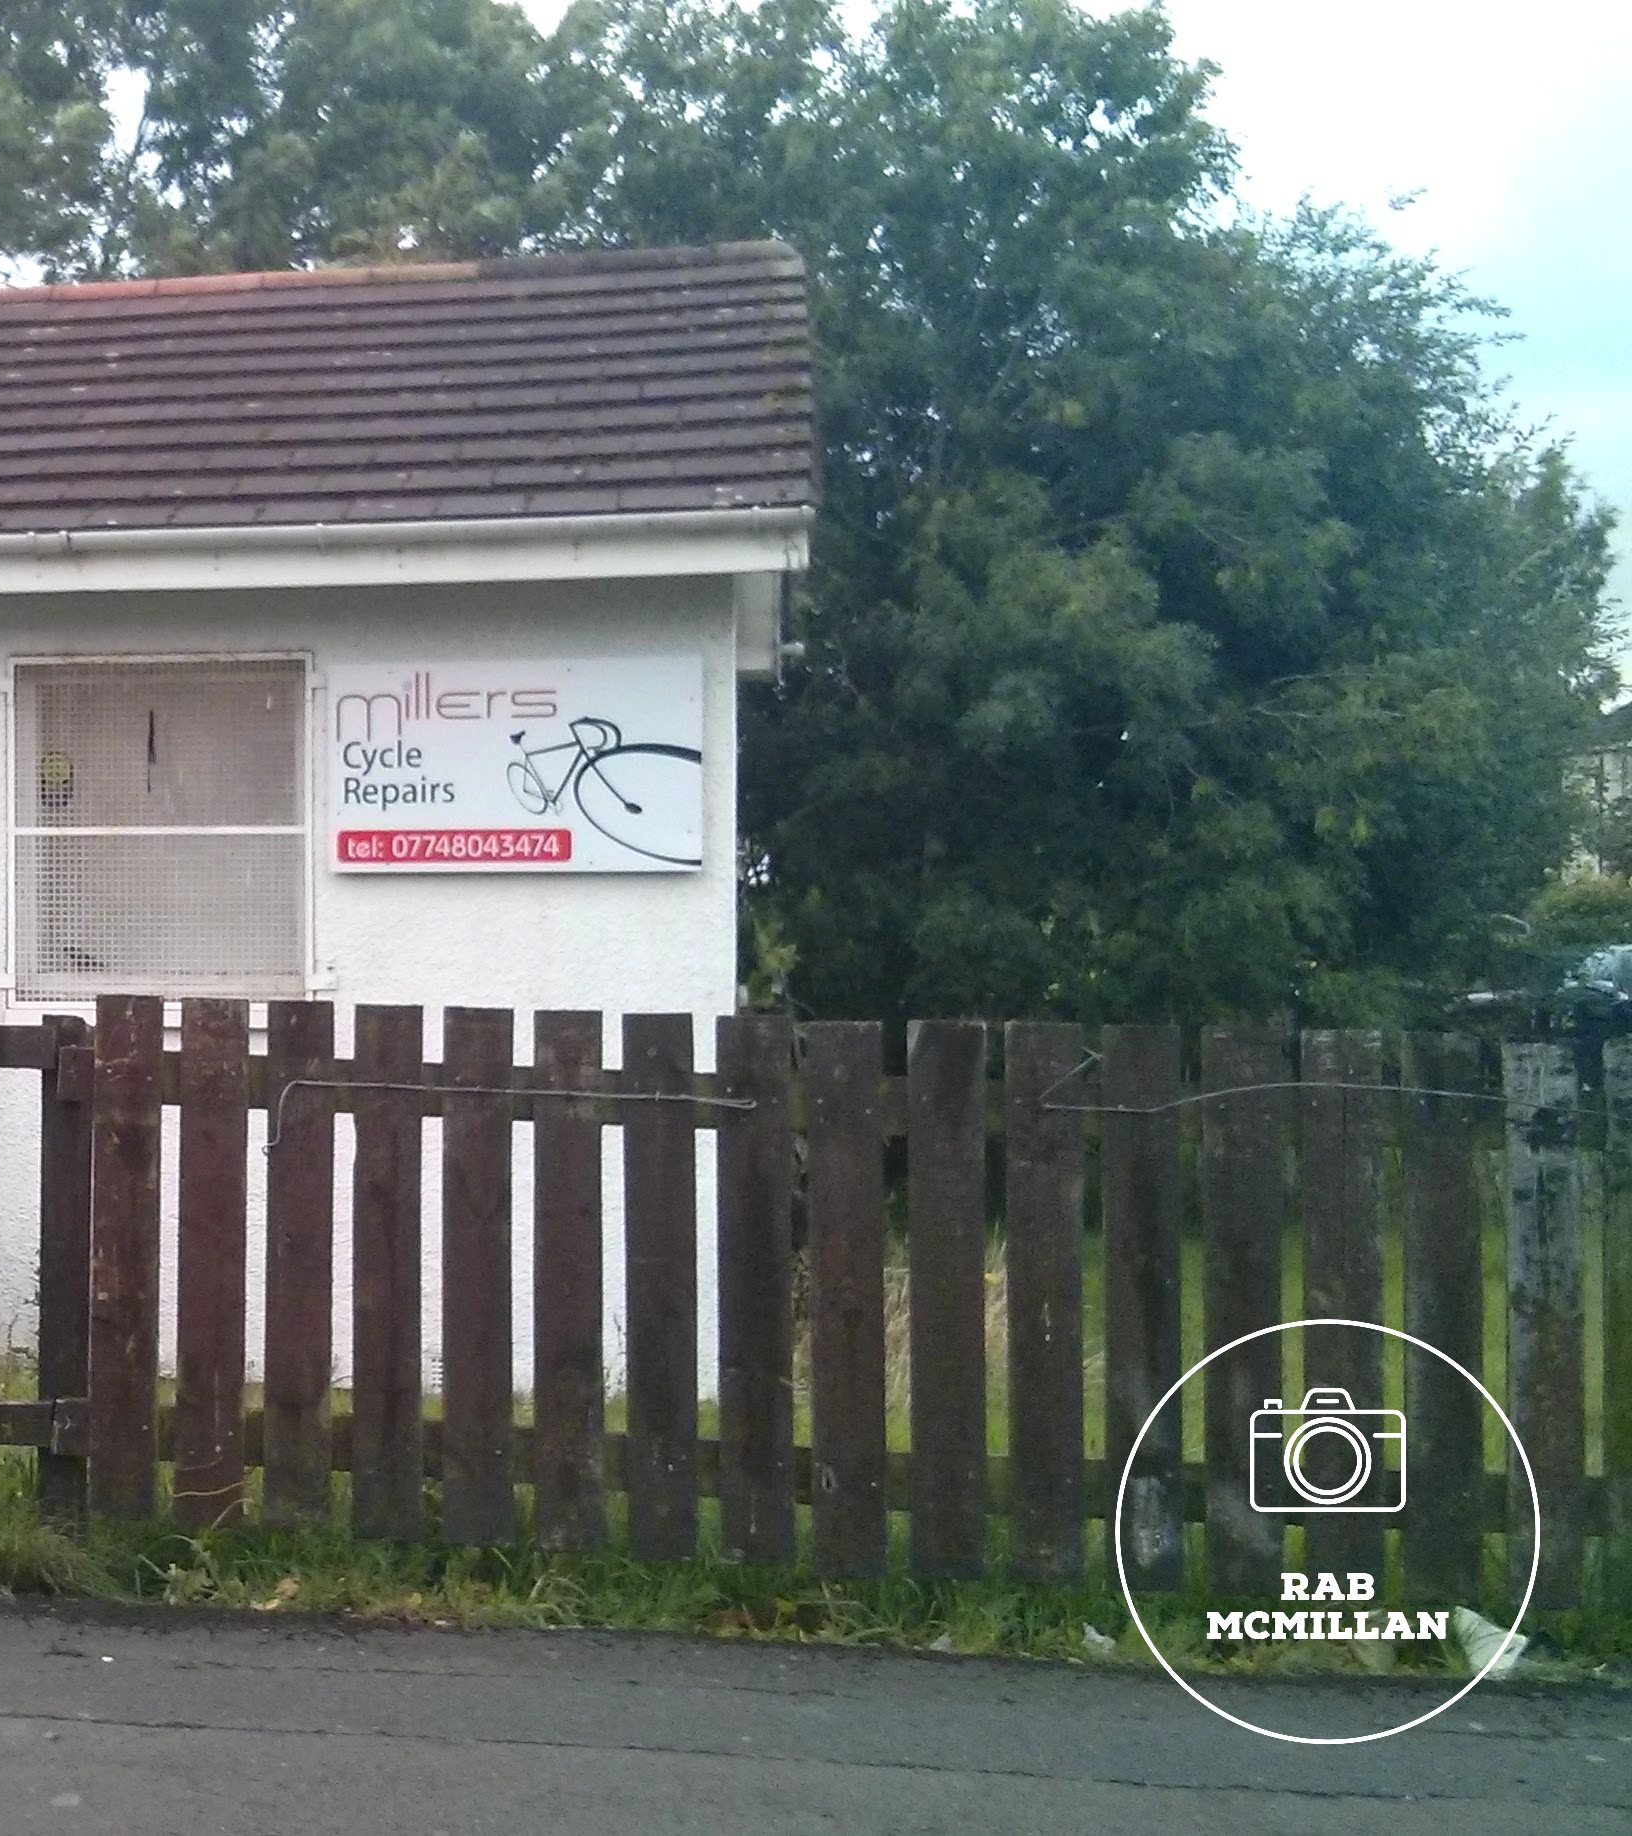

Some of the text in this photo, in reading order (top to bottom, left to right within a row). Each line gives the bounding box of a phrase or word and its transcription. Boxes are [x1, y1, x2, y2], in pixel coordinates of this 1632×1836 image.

[336, 671, 558, 742] millers
[342, 740, 422, 776] Cycle
[343, 776, 455, 811] Repairs
[347, 836, 560, 858] tel: 07748043474
